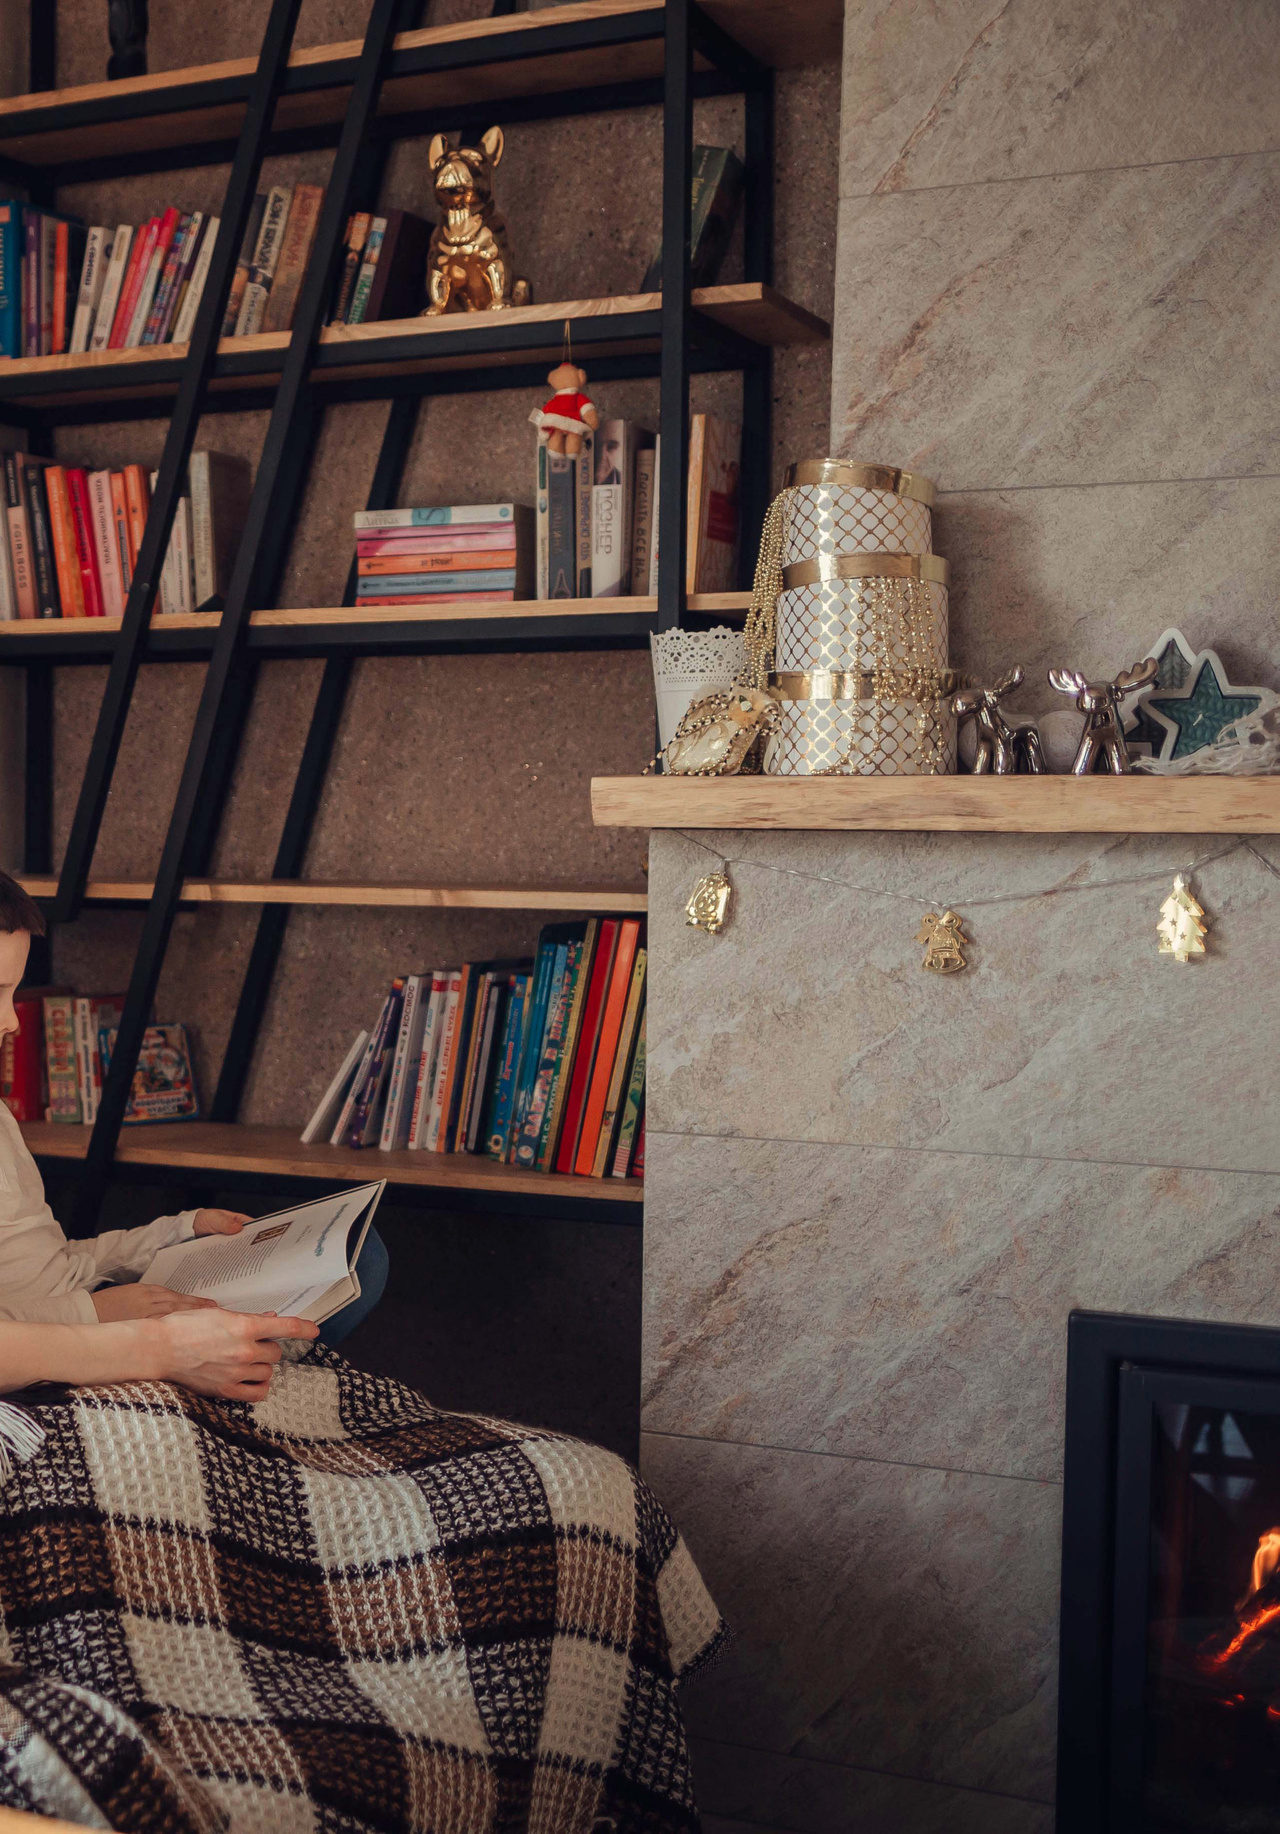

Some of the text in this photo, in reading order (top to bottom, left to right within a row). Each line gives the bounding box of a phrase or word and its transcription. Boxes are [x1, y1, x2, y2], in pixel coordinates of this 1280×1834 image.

[95, 477, 111, 564] ПЛАСТИЧНОСТЬ МОЗГА
[579, 457, 589, 560] ЧТО СКРЫВАЕТ КОЖА
[599, 488, 613, 554] ПОЗНЕР
[637, 472, 649, 522] ПОСЛАТЬ
[12, 523, 27, 588] #GIRLBOSS
[635, 527, 646, 553] ВСЕ
[401, 985, 415, 1027] КОСМОС
[522, 969, 576, 1137] ЗАВТРА В ШКОЛУ
[631, 1057, 646, 1084] SEEK
[546, 1073, 560, 1118] ЖУКОВА
